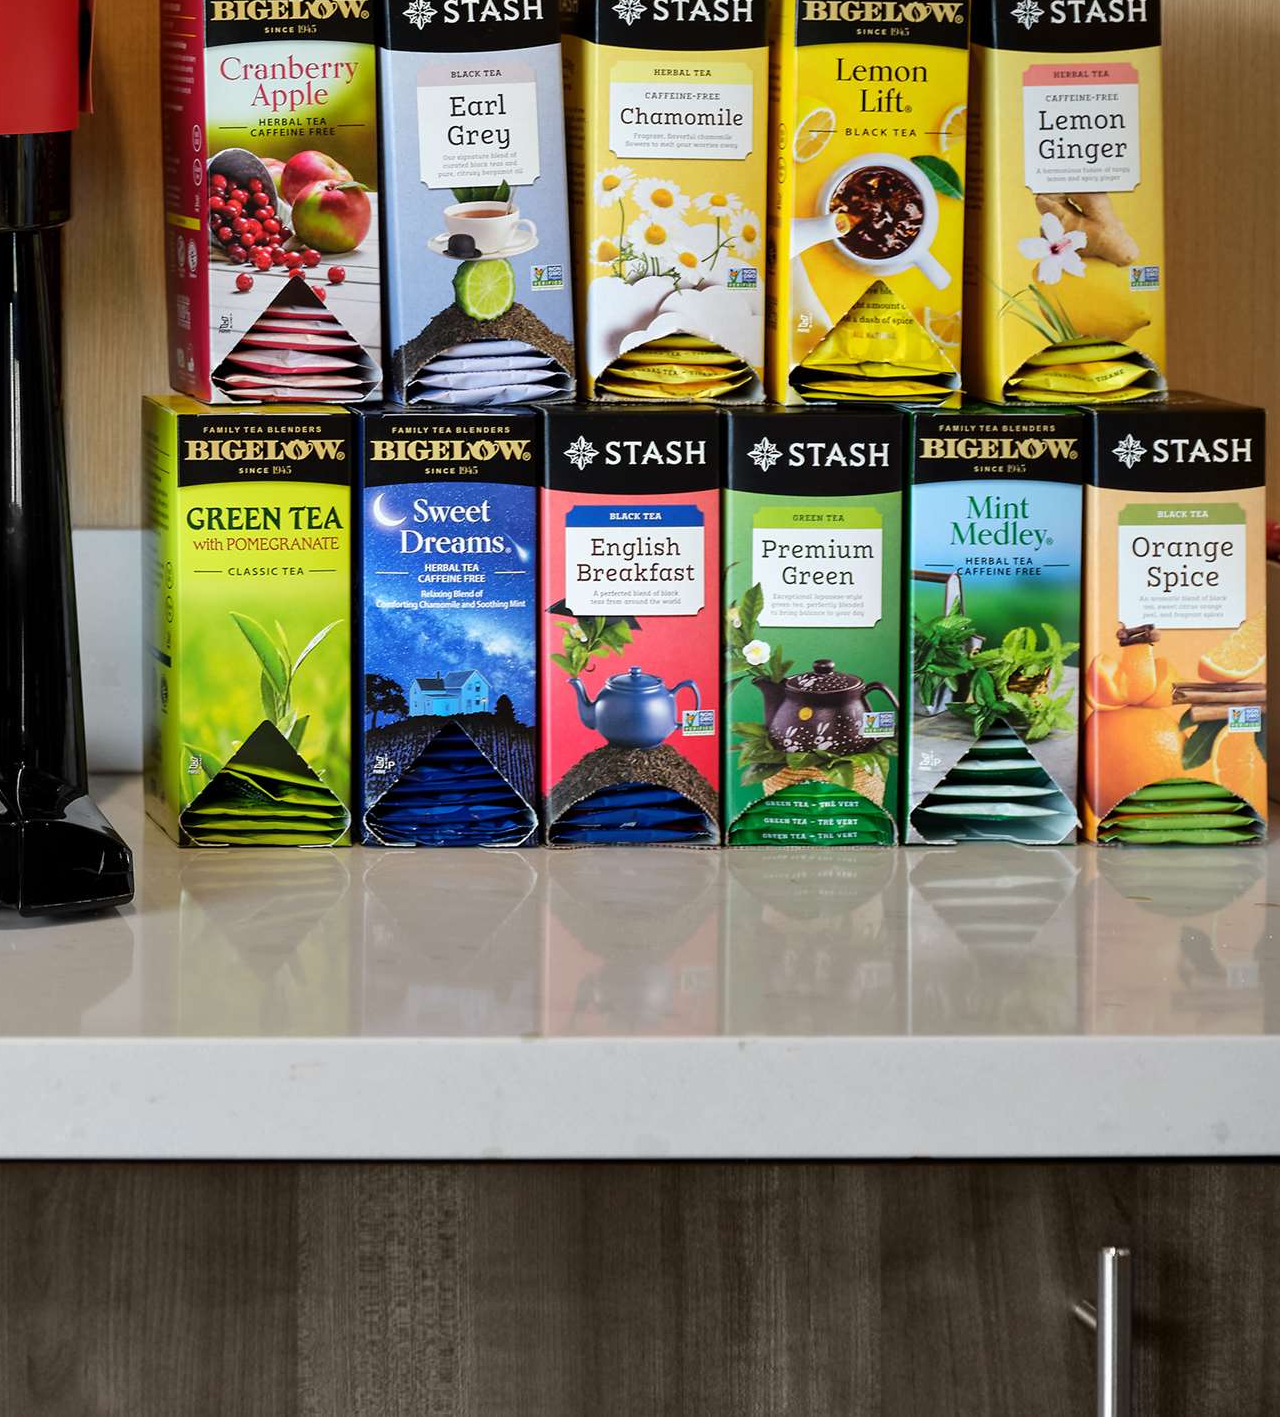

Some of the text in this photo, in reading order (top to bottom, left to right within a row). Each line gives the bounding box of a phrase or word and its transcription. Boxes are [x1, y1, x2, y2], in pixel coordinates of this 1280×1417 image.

[802, 0, 964, 24] BIGELOW
[298, 25, 317, 33] 1945
[220, 55, 359, 84] Cranberry
[836, 58, 927, 82] Lemon
[251, 81, 328, 112] Apple
[450, 94, 506, 117] Earl
[645, 92, 720, 100] CAFFEINE-FREE
[861, 88, 904, 112] Lift
[1046, 94, 1119, 102] CAFFEINE-FREE
[259, 118, 302, 126] HERBAL
[620, 108, 743, 126] Chamomile
[1039, 111, 1126, 130] Lemon
[251, 129, 305, 137] CAFFEINE
[447, 126, 510, 149] Grey
[845, 128, 916, 137] BLACK TEA
[1039, 138, 1127, 163] Ginger
[456, 426, 510, 434] BLENDERS
[184, 440, 345, 461] BIGELOW
[370, 440, 531, 461] BIGELOW
[605, 441, 706, 465] STASH
[789, 442, 889, 467] STASH
[919, 438, 1078, 459] BIGELOW
[1153, 438, 1252, 463] STASH
[273, 466, 292, 474] 1945
[459, 466, 478, 475] 1945
[187, 506, 343, 530] GREEN TEA
[413, 498, 491, 522] Sweet
[610, 512, 641, 520] BLACK
[967, 496, 1029, 519] Mint
[193, 537, 339, 551] with POMEGRANATE
[400, 530, 505, 554] Dreams
[950, 521, 1048, 551] Medley
[591, 537, 681, 560] English
[762, 539, 874, 558] Premium
[1132, 537, 1233, 562] Orange
[418, 574, 486, 583] CAFFEINE FREE
[577, 563, 695, 582] Breakfast
[782, 567, 854, 585] Green
[957, 567, 1041, 576] CAFFEINE FREE
[1147, 565, 1219, 592] Spice
[421, 590, 452, 599] Relaxing
[454, 590, 473, 598] Blend
[476, 600, 508, 609] Soothing
